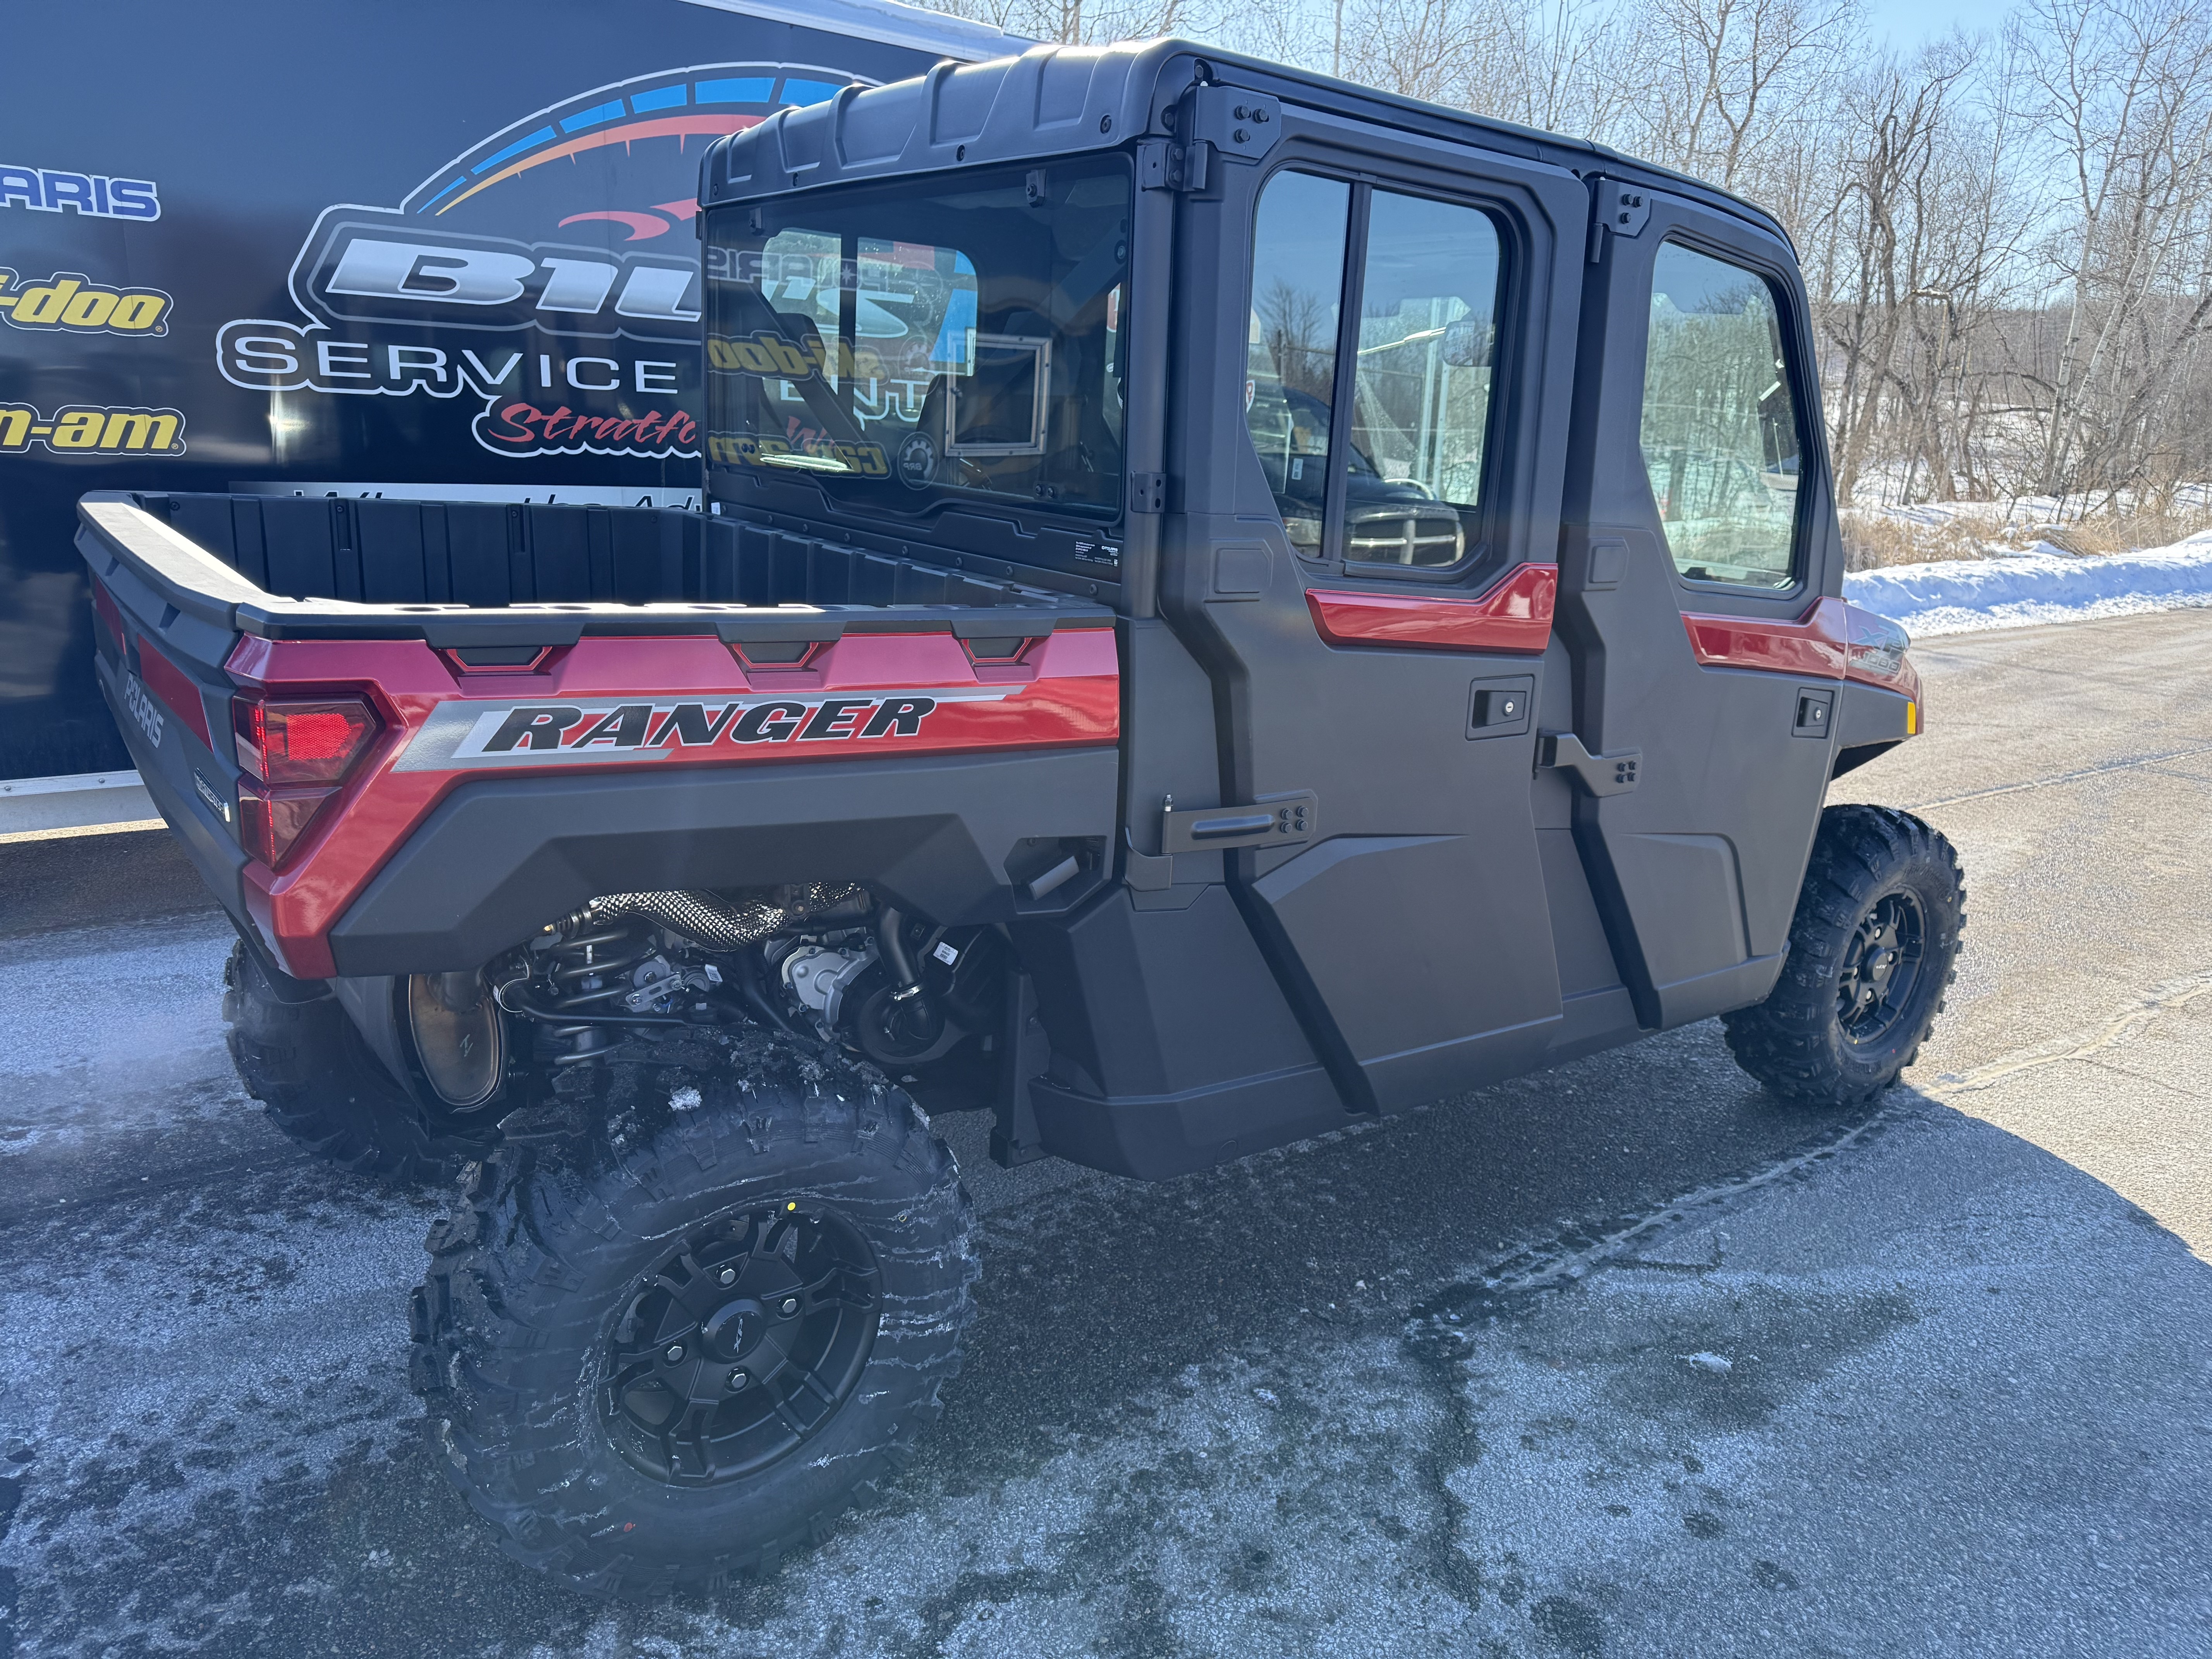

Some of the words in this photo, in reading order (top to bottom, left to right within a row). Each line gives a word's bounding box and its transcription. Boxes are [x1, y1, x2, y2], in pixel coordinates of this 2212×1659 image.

[234, 336, 678, 394] SERVICE
[488, 403, 696, 444] Stratfo
[124, 672, 164, 748] POLARIS
[481, 697, 937, 753] RANGER
